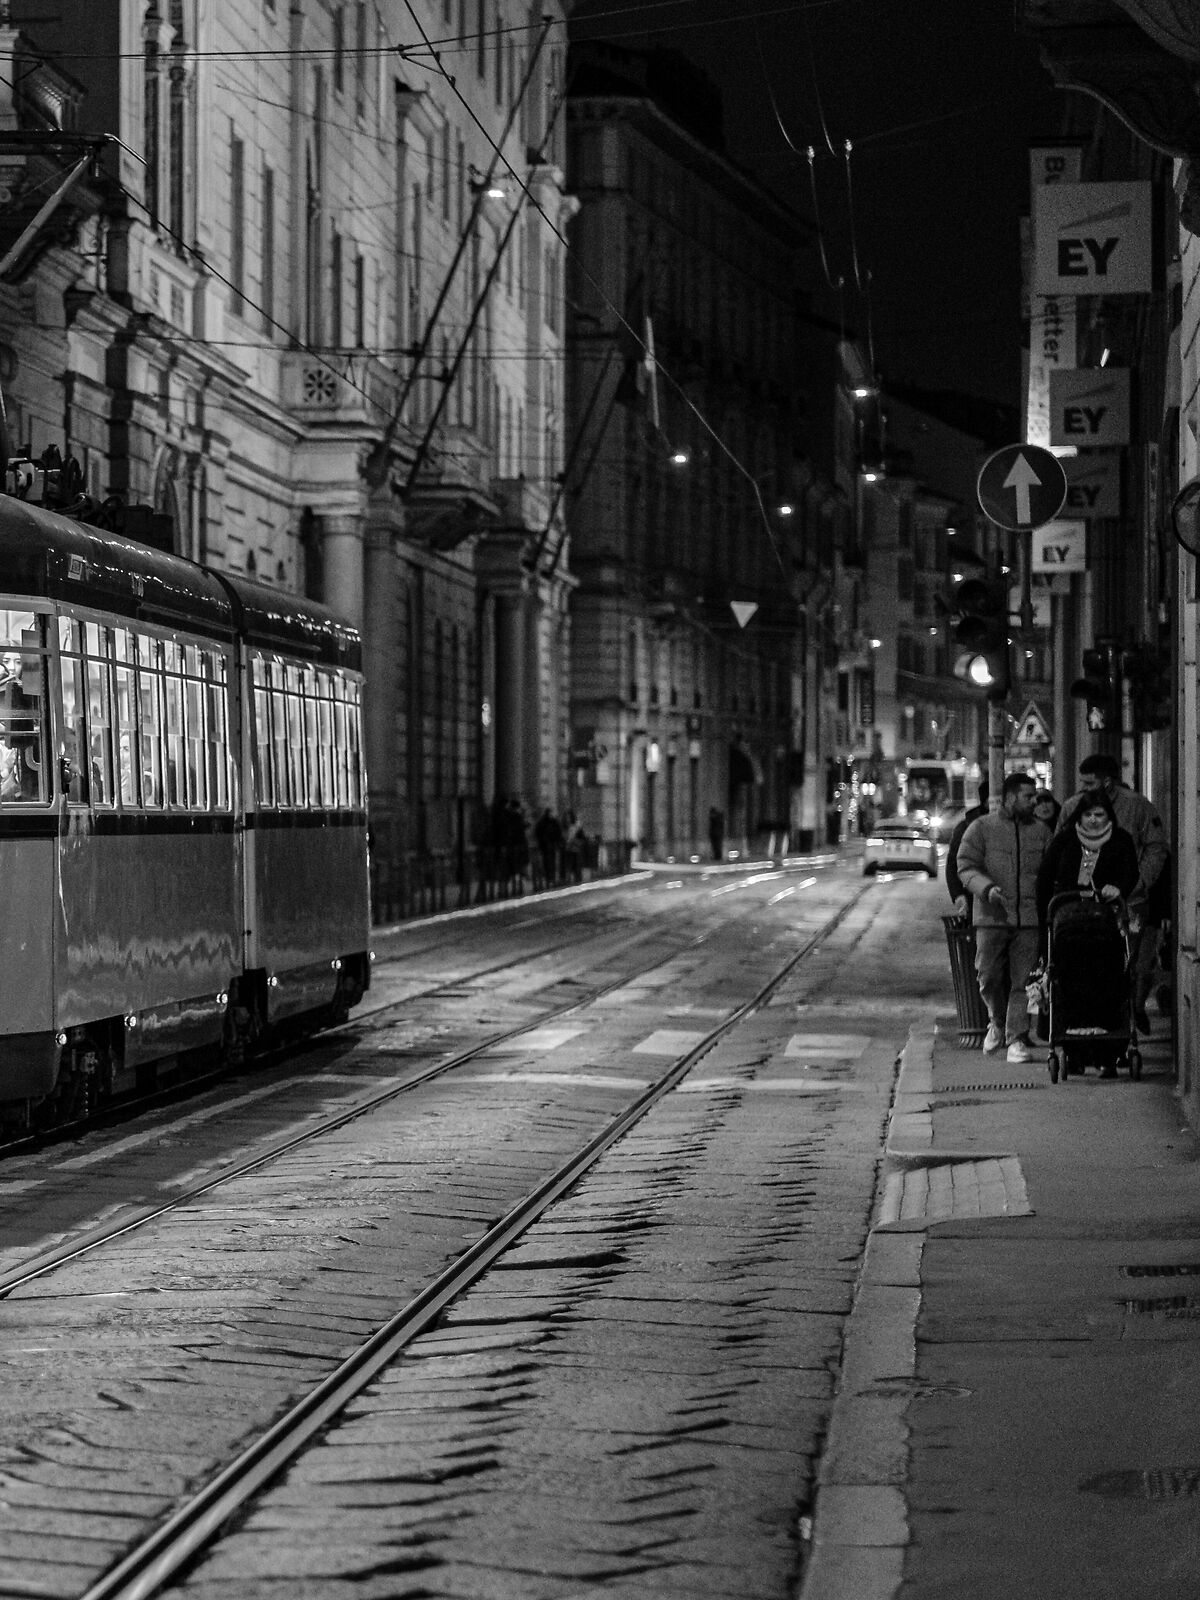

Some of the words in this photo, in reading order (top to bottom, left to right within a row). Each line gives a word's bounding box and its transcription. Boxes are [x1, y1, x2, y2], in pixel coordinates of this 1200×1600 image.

[1057, 237, 1120, 276] EY
[1043, 294, 1064, 363] etter
[1063, 406, 1106, 434] EY
[1068, 485, 1101, 508] EY
[1042, 545, 1070, 563] EY
